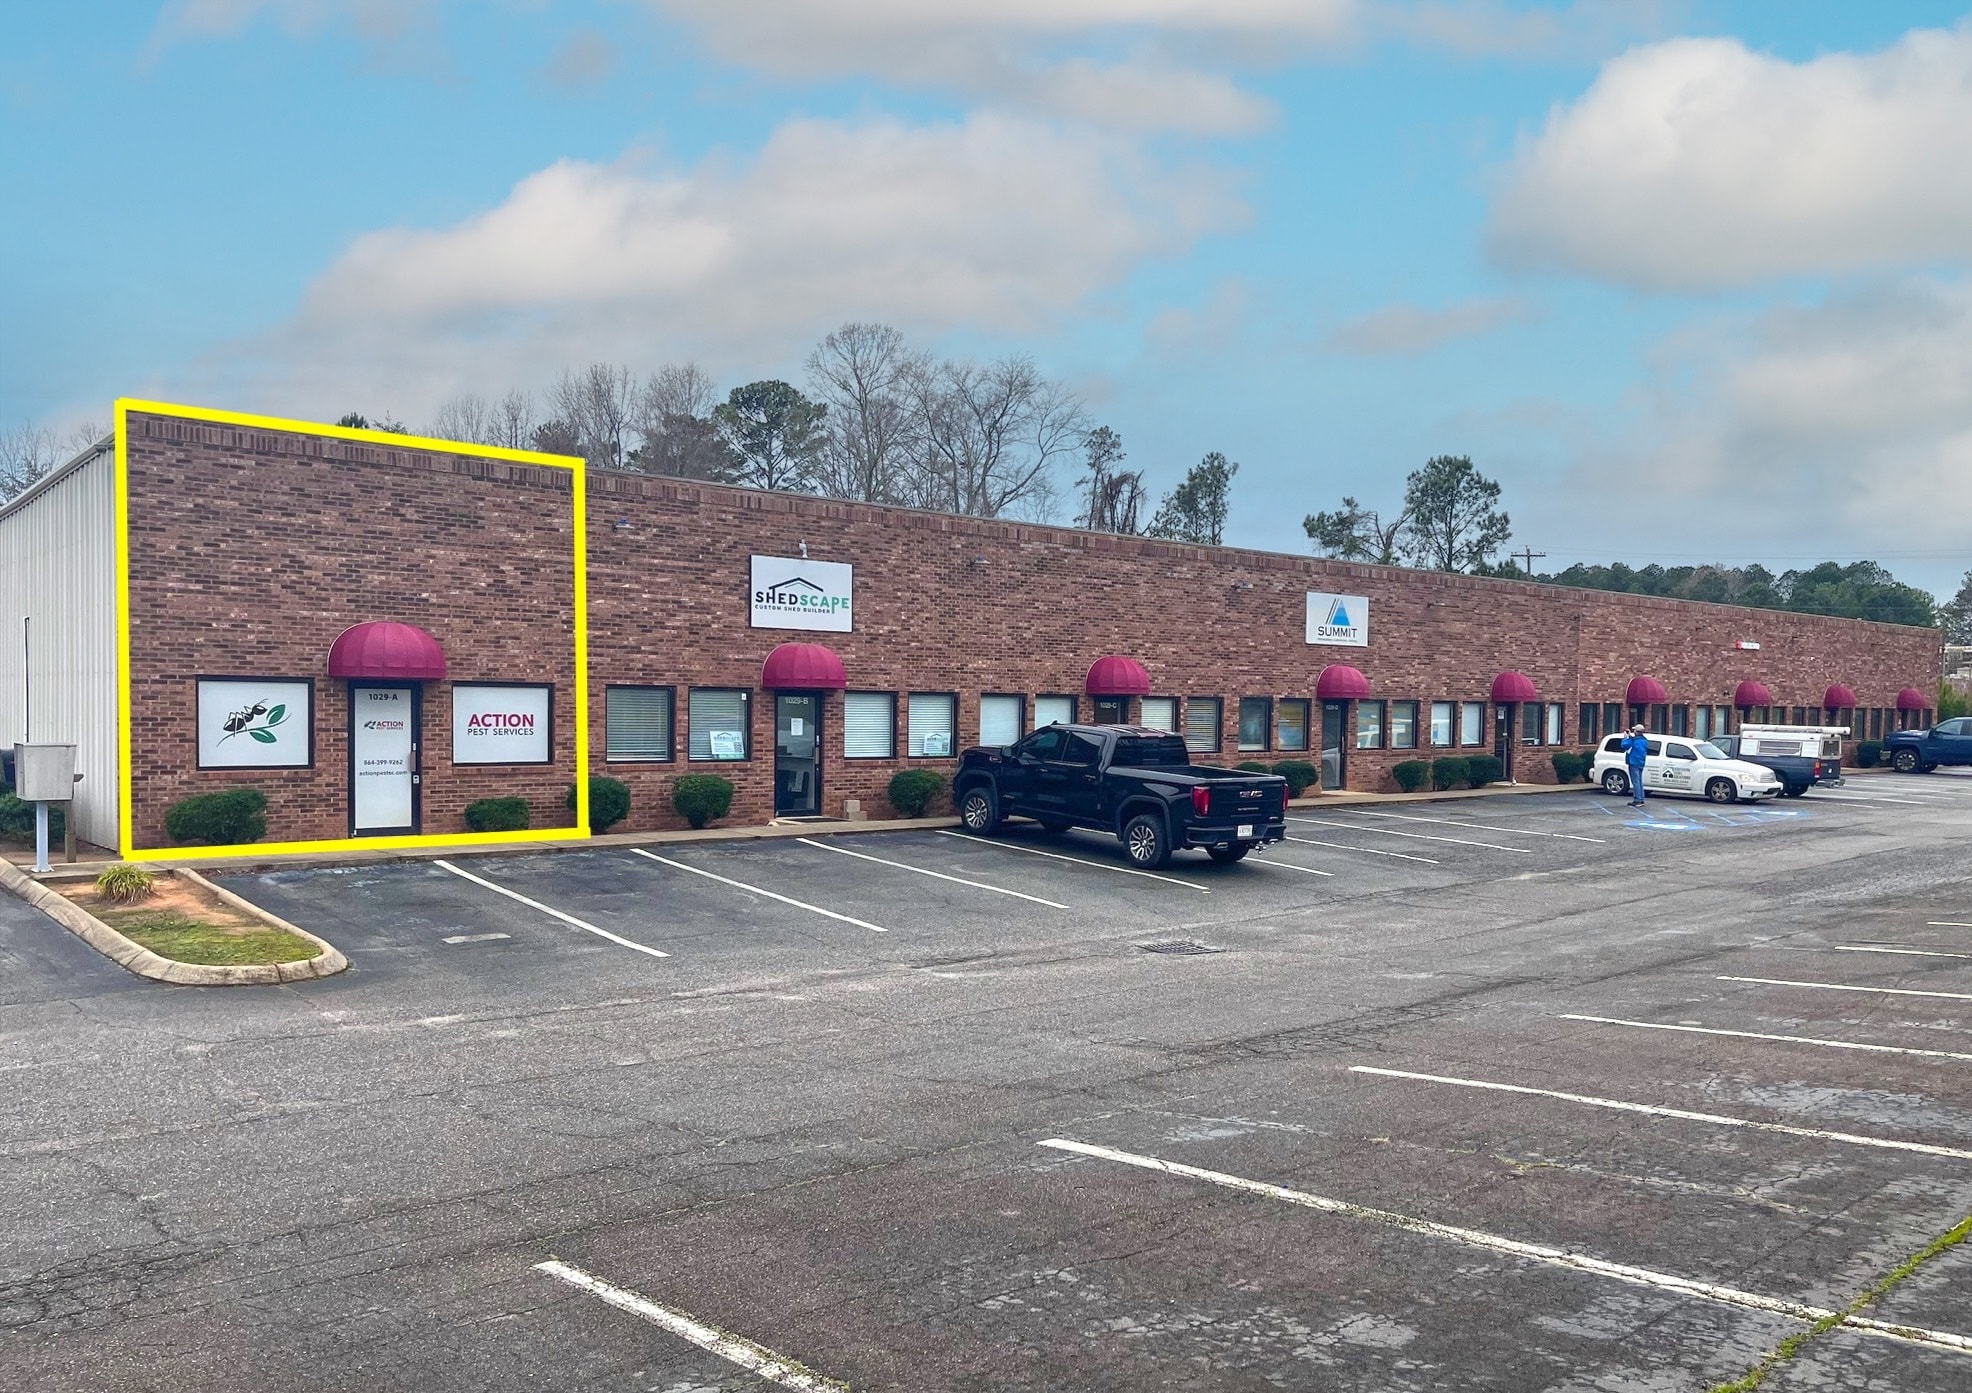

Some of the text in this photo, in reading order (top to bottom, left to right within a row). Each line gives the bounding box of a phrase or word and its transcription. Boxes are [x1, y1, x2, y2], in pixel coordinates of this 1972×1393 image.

[755, 587, 850, 614] SHEDSCAPE
[1317, 625, 1358, 638] SUMMIT
[368, 693, 398, 701] 1029-A
[785, 697, 809, 705] 1029-B
[468, 713, 534, 727] ACTION
[467, 728, 535, 736] PEST SERVICES
